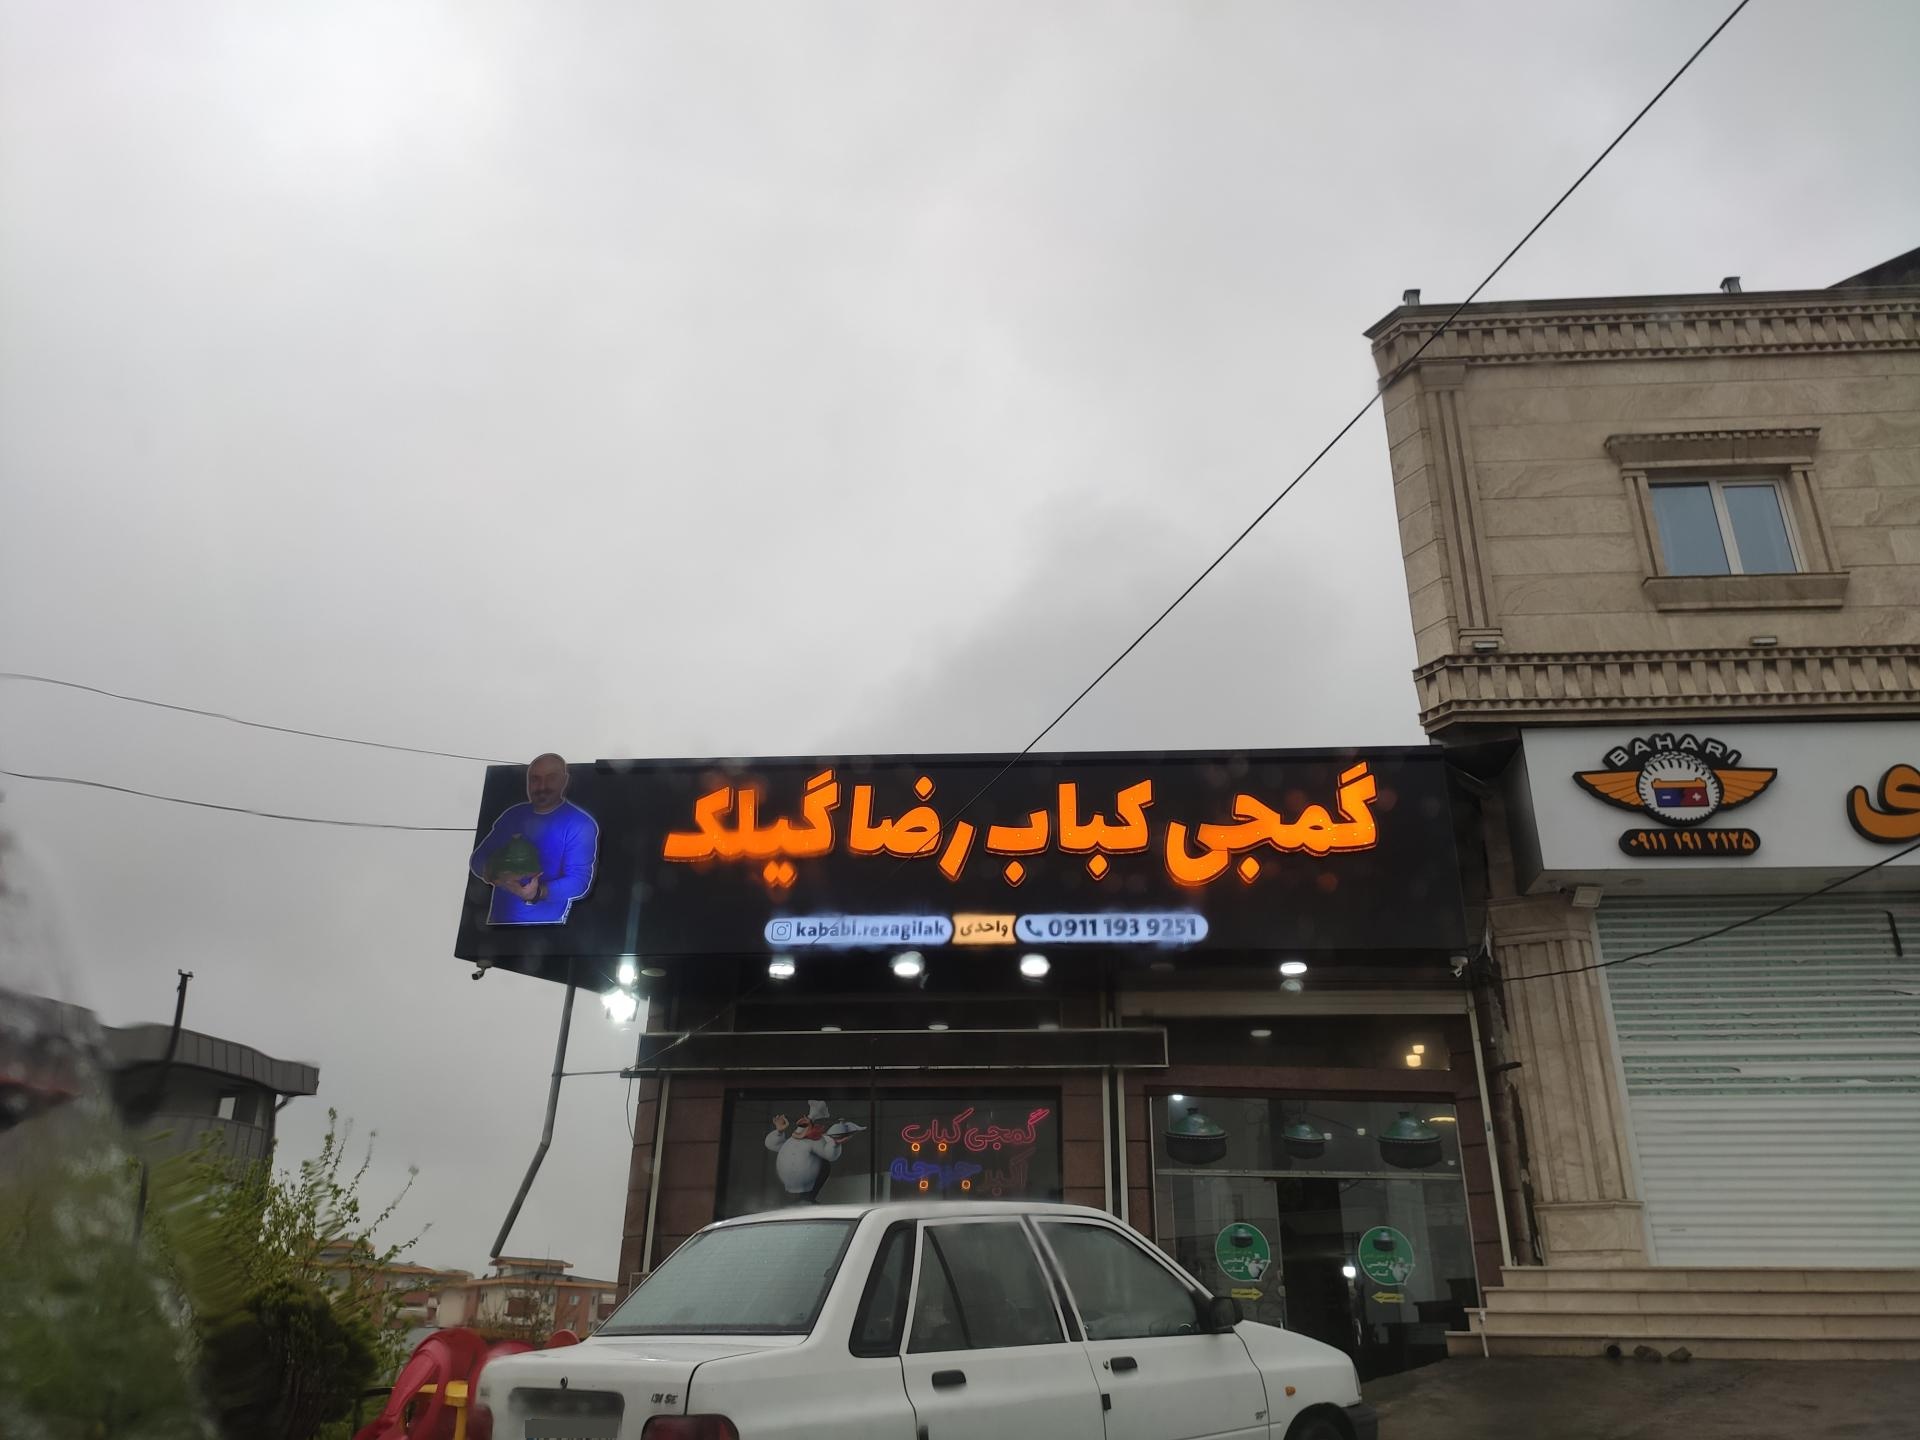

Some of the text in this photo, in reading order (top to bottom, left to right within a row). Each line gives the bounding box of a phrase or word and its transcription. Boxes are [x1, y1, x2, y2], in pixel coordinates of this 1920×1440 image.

[1609, 735, 1737, 767] BAHARI
[662, 762, 1377, 890] گمجی کباب رضا گیلک
[1630, 831, 1667, 849] ۰۹۱۱
[1673, 831, 1702, 849] ۱۹۱
[1048, 918, 1197, 937] 0911 193 9251
[901, 1107, 1050, 1153] گمجی کباب
